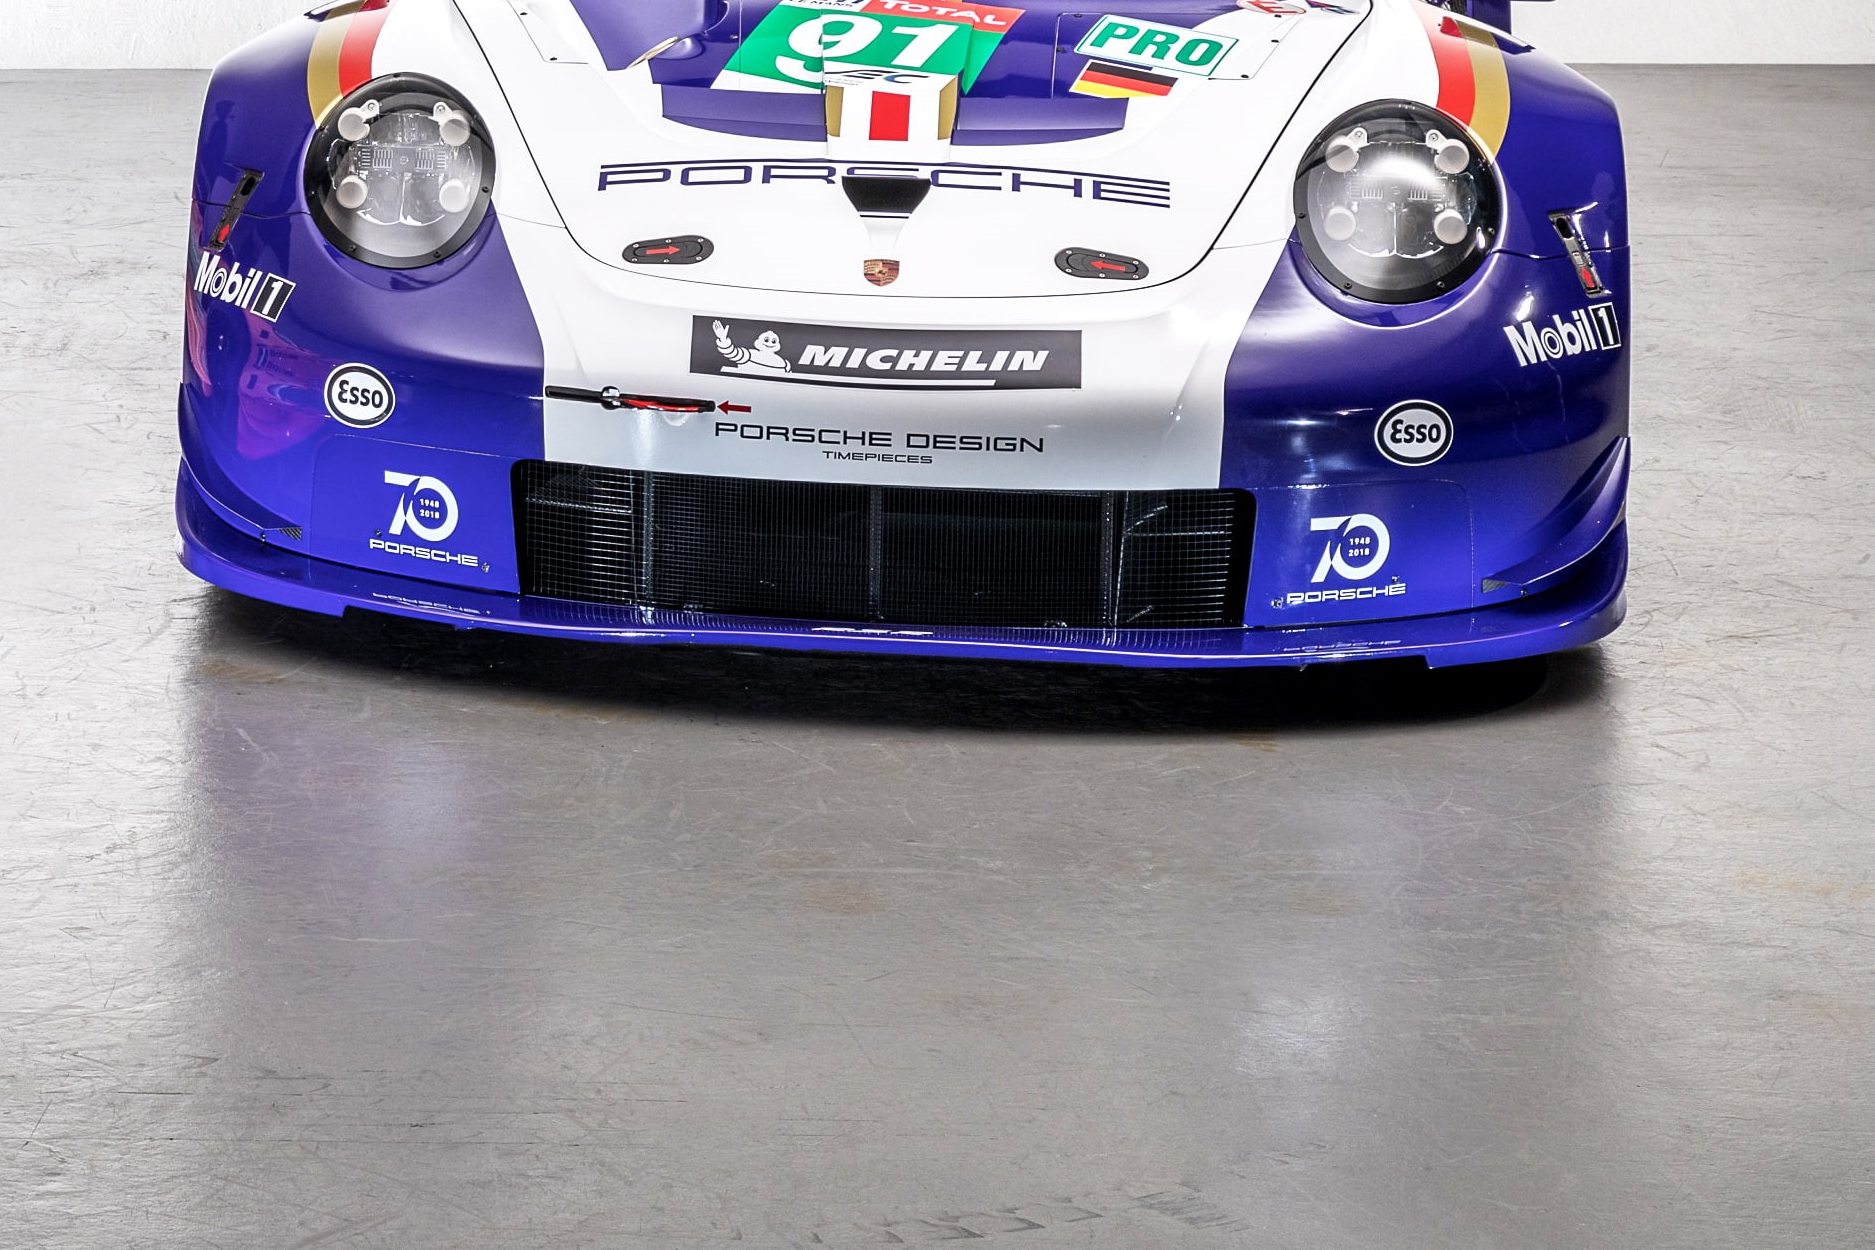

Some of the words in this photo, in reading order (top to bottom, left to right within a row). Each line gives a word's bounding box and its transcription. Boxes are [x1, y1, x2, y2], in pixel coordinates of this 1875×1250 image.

[776, 14, 959, 84] 91
[1090, 20, 1224, 67] PRO
[193, 251, 264, 310] Mobil
[1504, 310, 1597, 367] Mobil
[798, 344, 1050, 372] MICHELIN
[337, 379, 384, 411] Esso
[715, 422, 892, 448] PORSCHE
[906, 433, 1044, 453] DESIGN
[1389, 418, 1442, 445] Esso
[822, 450, 933, 465] TIMEPIECES
[384, 470, 459, 542] 70
[419, 498, 440, 508] 1948
[419, 508, 440, 519] 2018
[369, 538, 480, 568] PORSCHE
[1310, 513, 1391, 583] 70
[1348, 547, 1370, 557] 2018
[1349, 536, 1371, 546] 1948
[1286, 582, 1407, 603] PORSCHE
